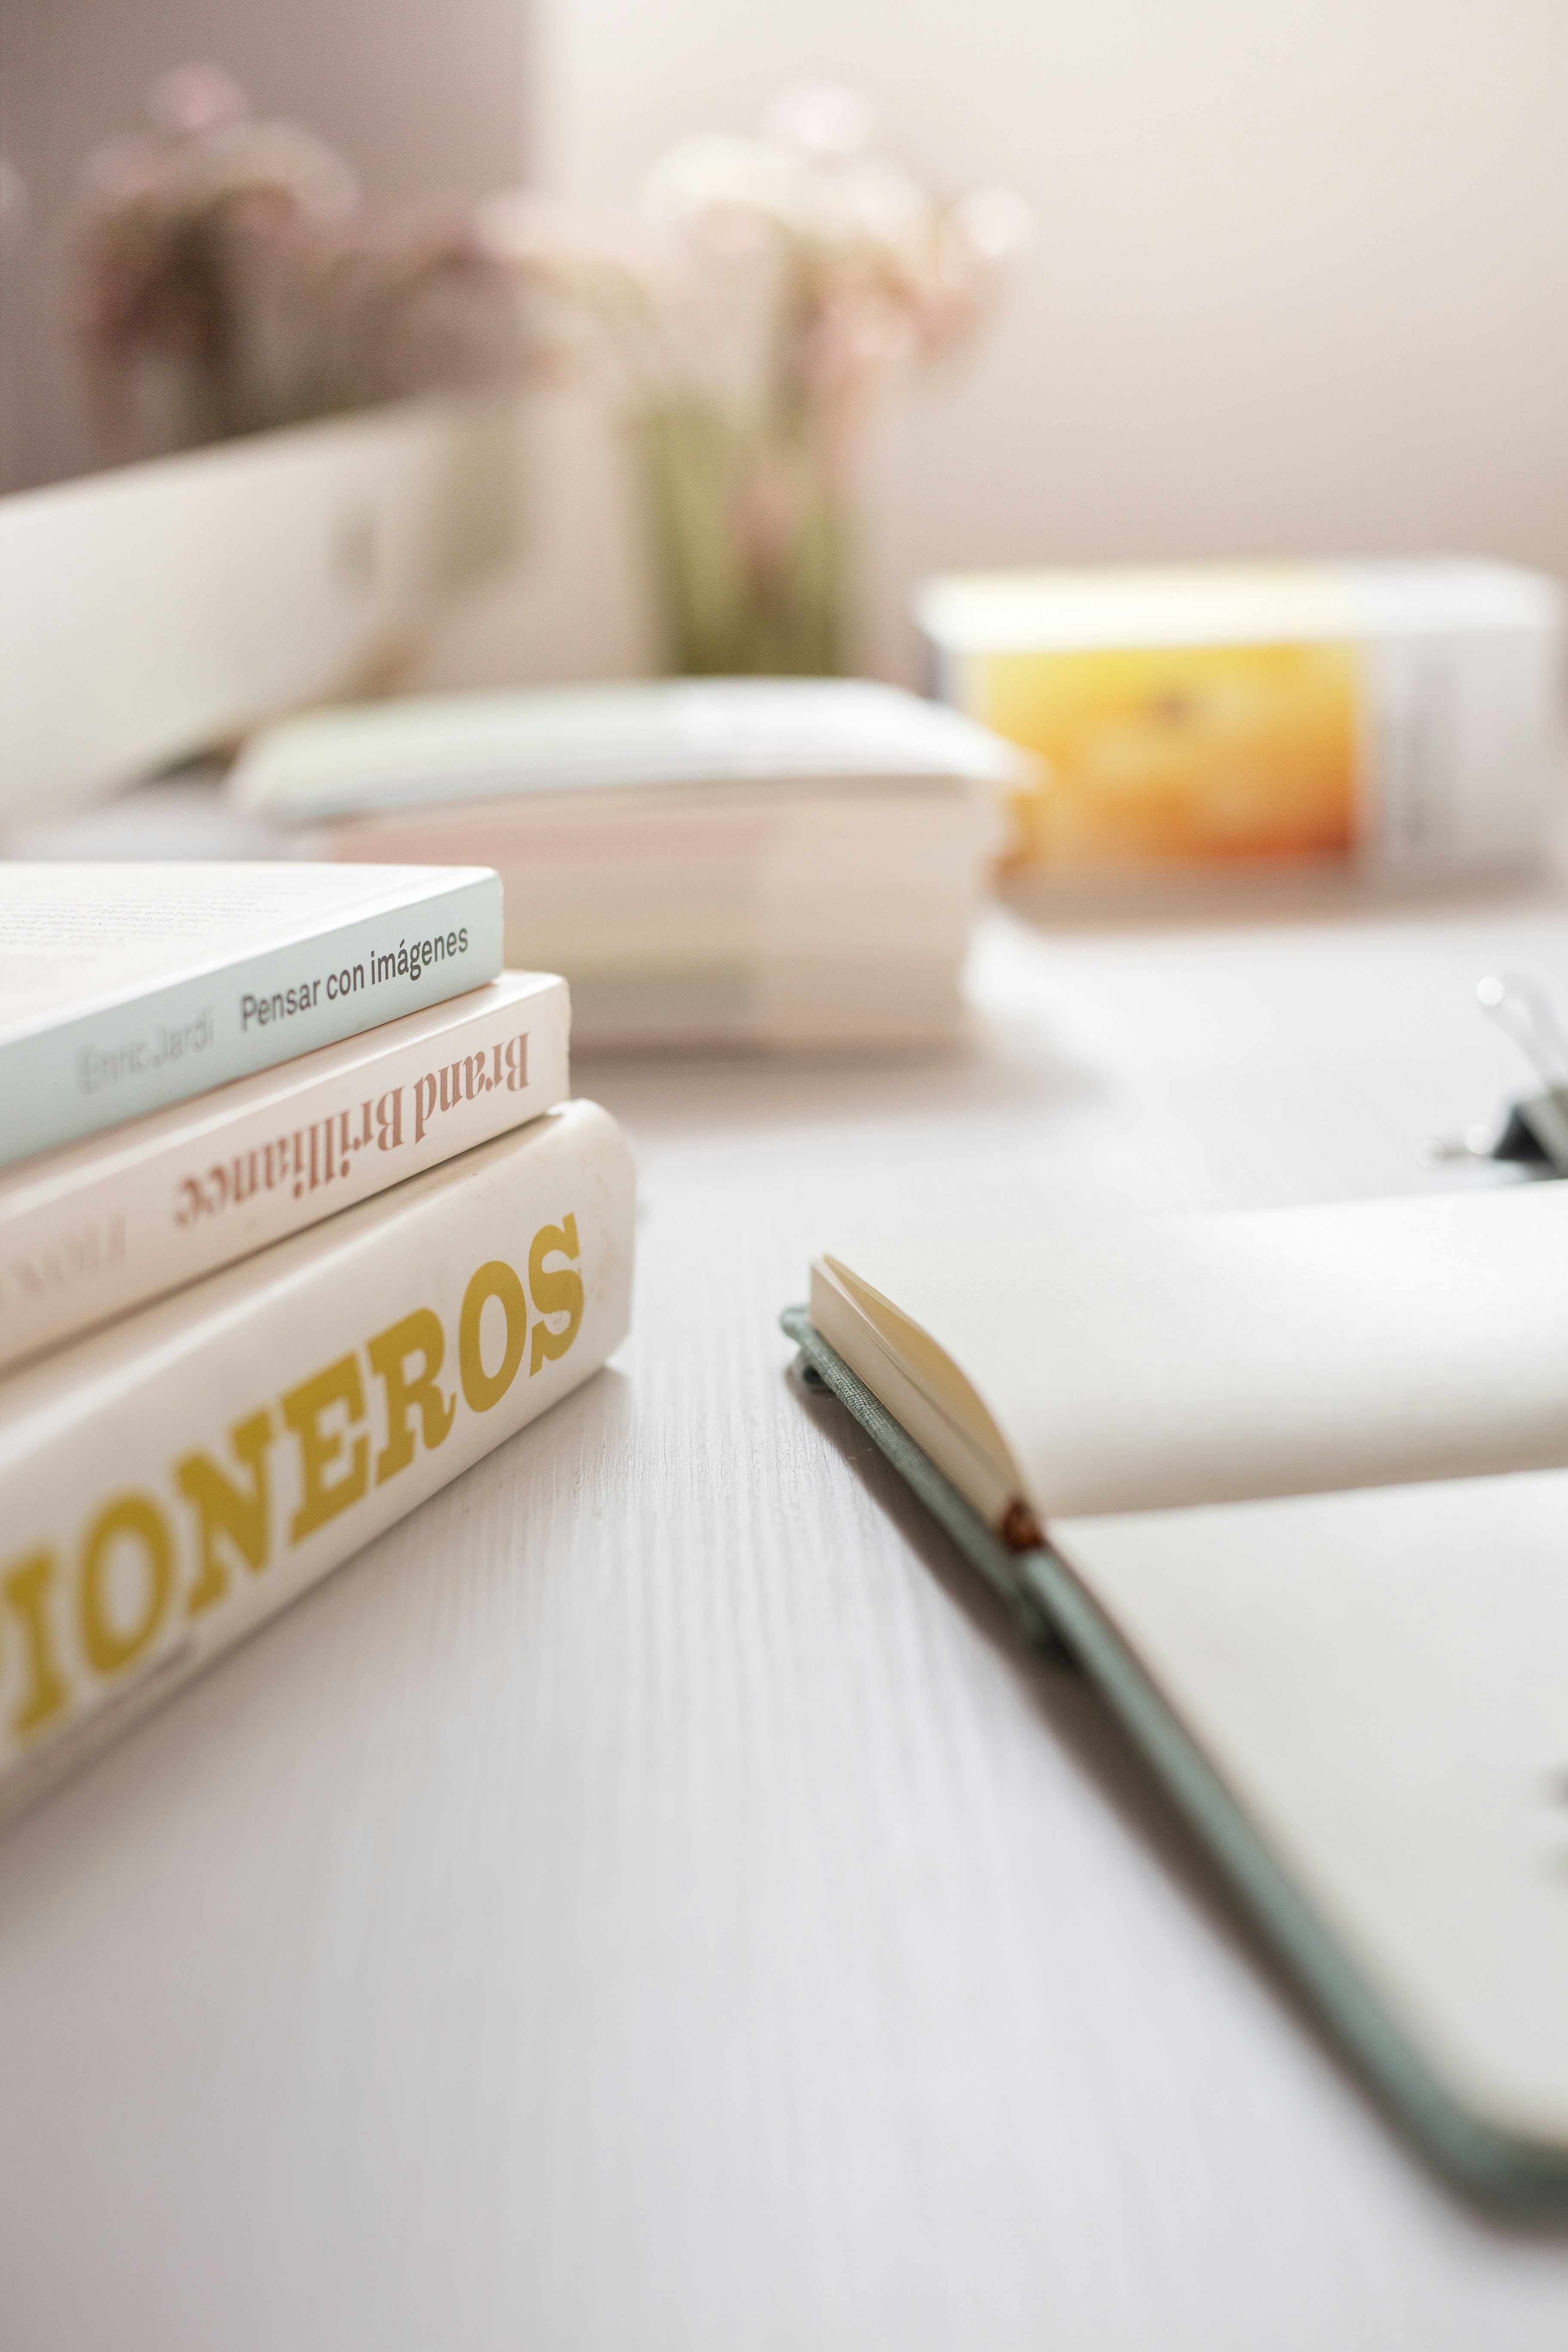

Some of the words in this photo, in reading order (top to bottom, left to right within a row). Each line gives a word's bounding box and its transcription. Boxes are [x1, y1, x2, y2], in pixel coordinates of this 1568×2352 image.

[241, 979, 321, 1032] Pensar
[326, 964, 365, 1001] con
[371, 927, 469, 981] imágenes
[414, 1032, 530, 1144] Brand
[174, 1086, 404, 1232] Brilliance
[0, 1211, 585, 1743] IONEROS
